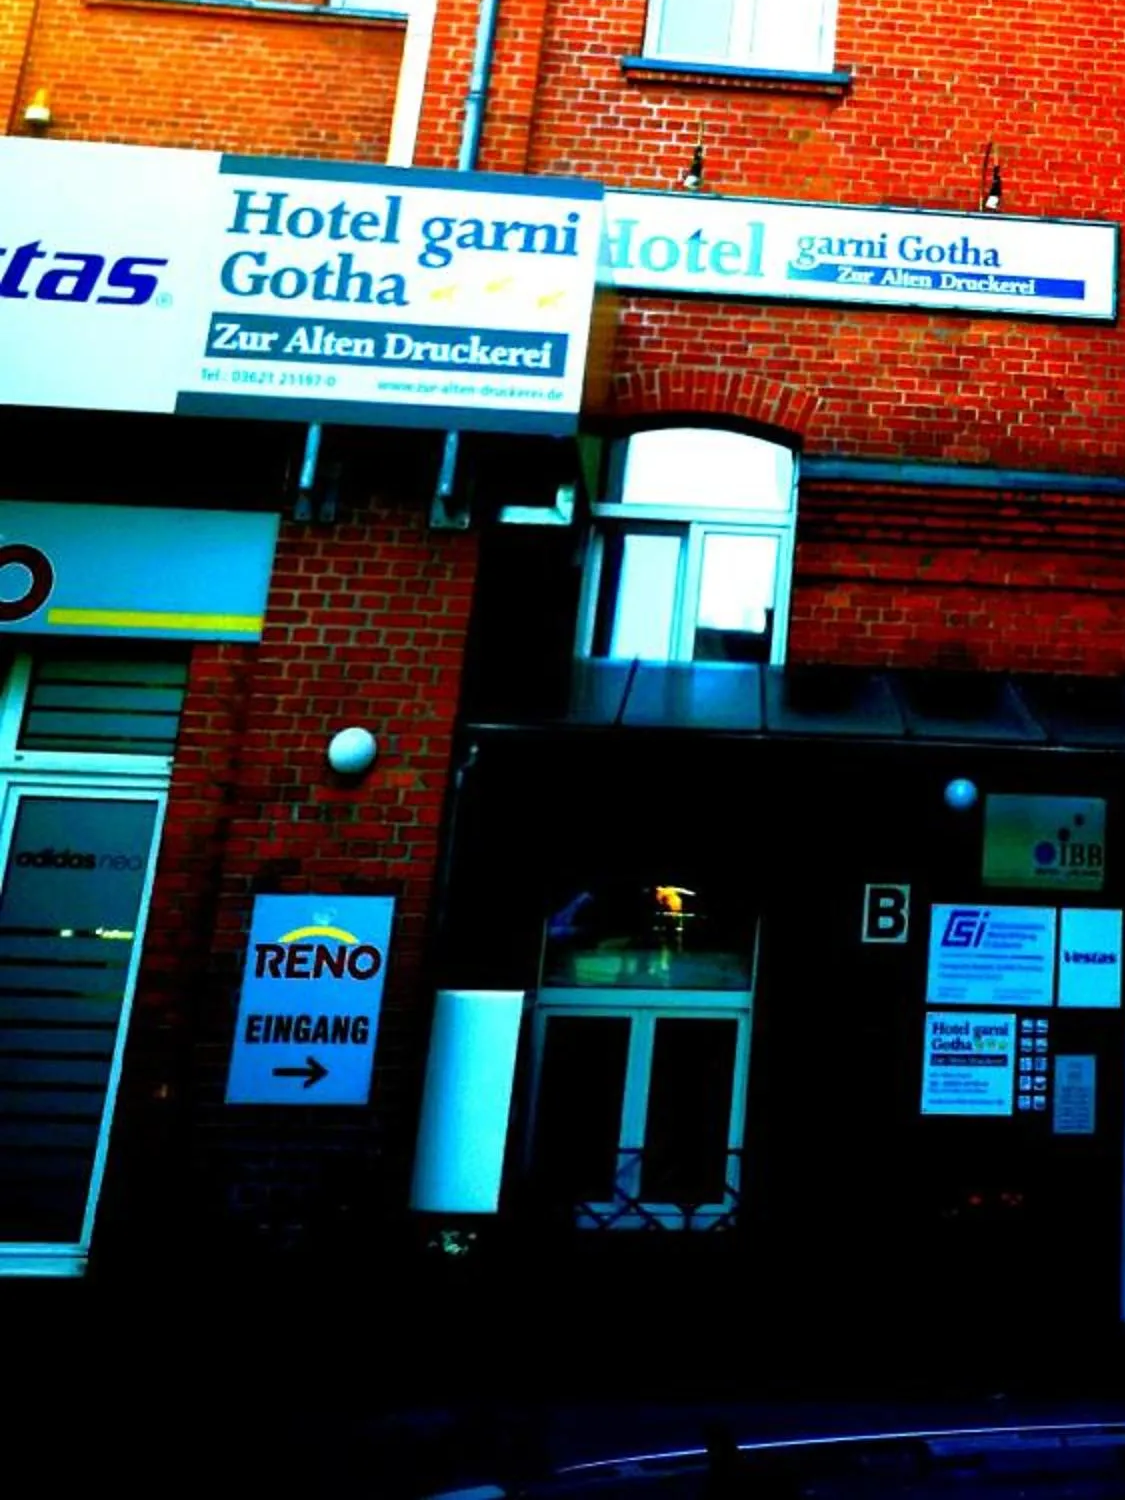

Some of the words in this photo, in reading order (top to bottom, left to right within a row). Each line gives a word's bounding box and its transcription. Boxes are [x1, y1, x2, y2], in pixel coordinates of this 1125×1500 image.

[225, 189, 403, 244] Hotel
[418, 212, 581, 269] garni
[796, 233, 889, 267] garni
[898, 235, 1002, 268] Gotha
[0, 240, 169, 306] tas
[220, 251, 410, 307] Gotha
[837, 266, 875, 285] Zur
[881, 268, 933, 288] Alten
[940, 273, 1036, 296] Druckerei
[211, 323, 279, 353] Zur
[284, 326, 376, 359] Alten
[383, 333, 552, 369] Druckerei
[15, 846, 97, 870] adidas
[99, 852, 143, 870] neo
[869, 888, 906, 938] B
[254, 943, 382, 981] RENO
[245, 1014, 370, 1045] EINGANG
[931, 1037, 973, 1051] Gotha
[932, 1019, 970, 1035] Hotel
[973, 1021, 1009, 1041] garni
